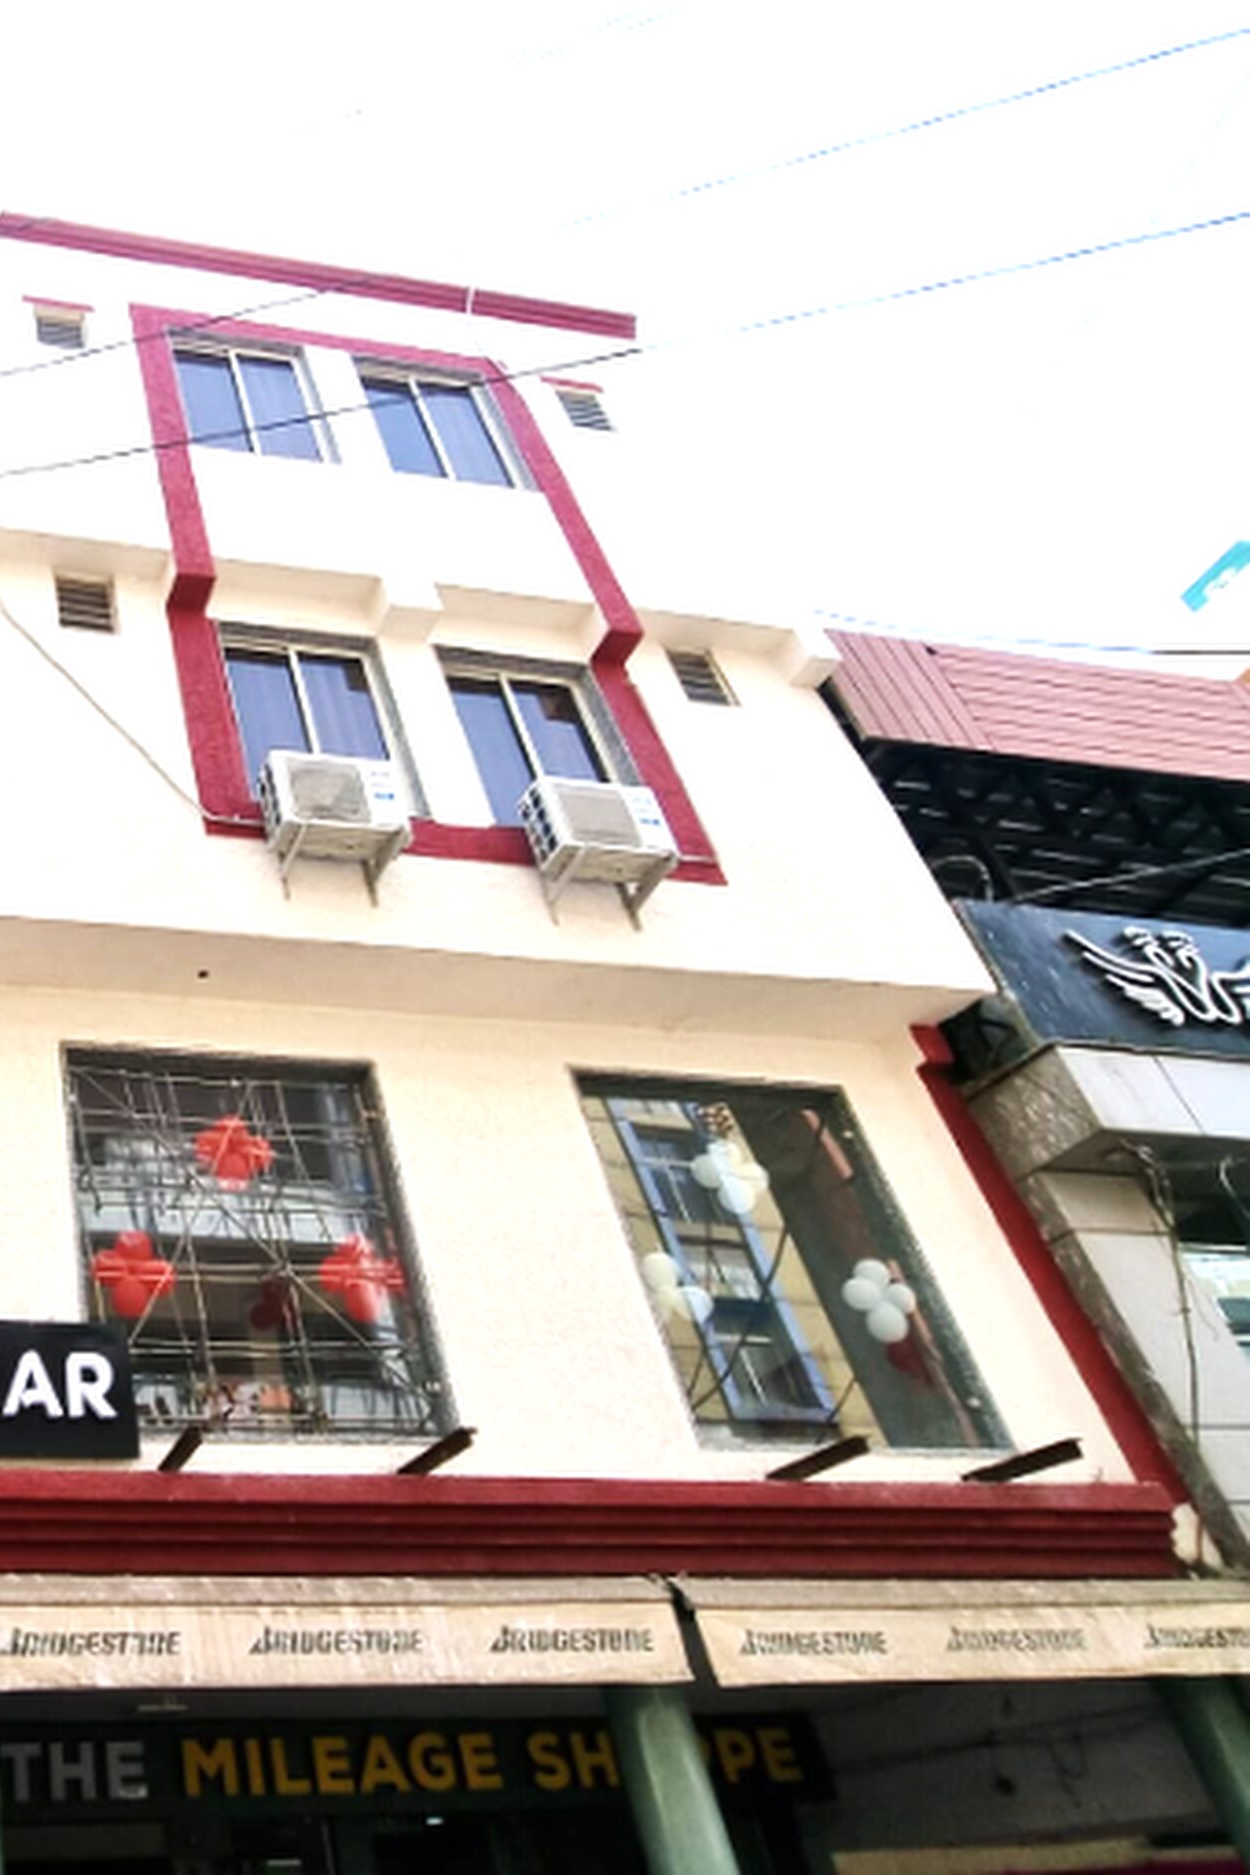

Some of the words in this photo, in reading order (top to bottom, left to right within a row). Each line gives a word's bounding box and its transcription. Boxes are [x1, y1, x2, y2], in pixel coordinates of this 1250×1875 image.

[488, 1624, 655, 1653] BRIDGESTONE
[0, 1740, 148, 1803] THE
[181, 1730, 504, 1798] MILEAGE
[526, 1728, 804, 1791] SHPE
